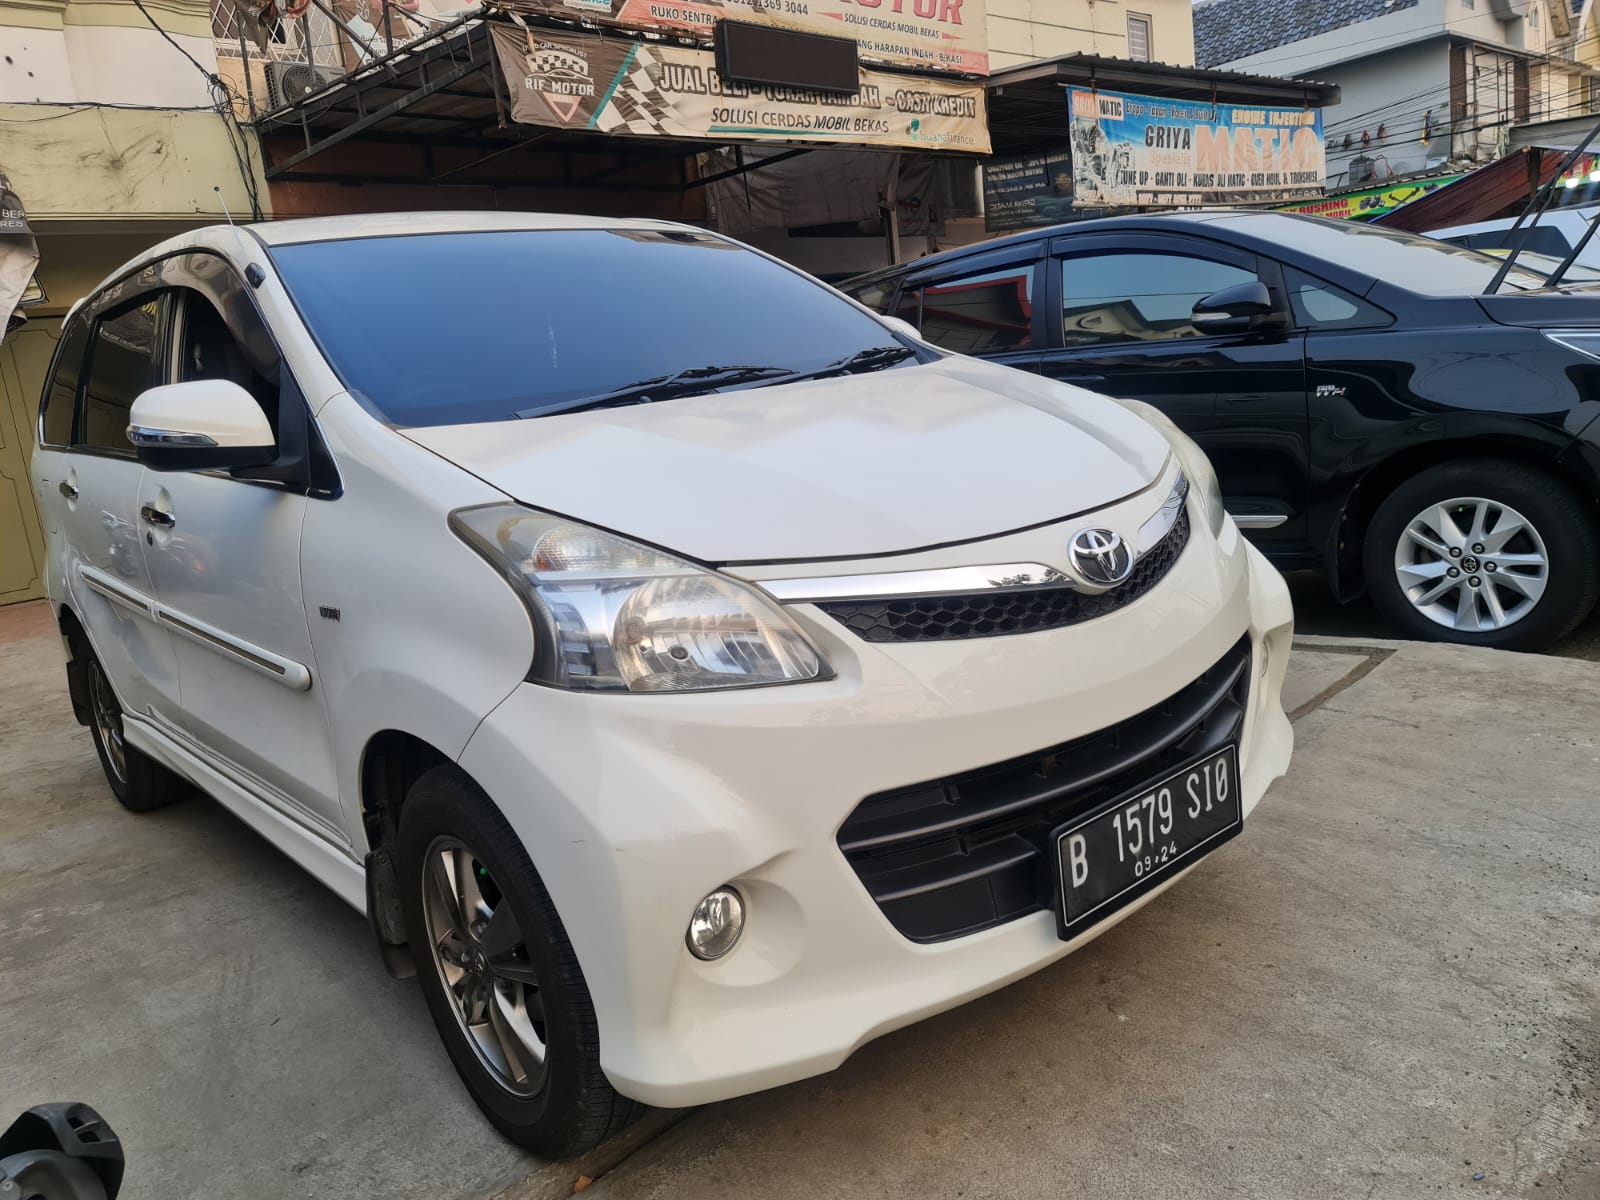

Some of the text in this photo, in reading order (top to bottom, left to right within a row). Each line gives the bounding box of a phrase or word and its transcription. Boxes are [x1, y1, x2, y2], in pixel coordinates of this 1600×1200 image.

[651, 5, 680, 19] RUKO
[682, 11, 719, 25] SENTRA
[784, 1, 809, 15] 3044
[844, 13, 940, 39] SOLUSI CERDAS MOBIL BEKAS
[874, 42, 910, 55] HARAPAN
[911, 47, 934, 60] INDAH
[525, 78, 595, 96] RIF MOTOR
[659, 63, 707, 95] JUAL
[1098, 99, 1122, 117] MATIC
[711, 107, 889, 133] SOLUSI CERDAS MOBIL BEKAS
[1269, 111, 1315, 126] INJECTI
[1145, 125, 1318, 171] GRIYA MATIC
[1120, 170, 1136, 186] TUNE
[1139, 170, 1149, 186] UP
[1155, 171, 1175, 187] GANTI
[1176, 172, 1187, 187] OLI
[1069, 834, 1088, 888] B
[1112, 788, 1173, 862] 1579
